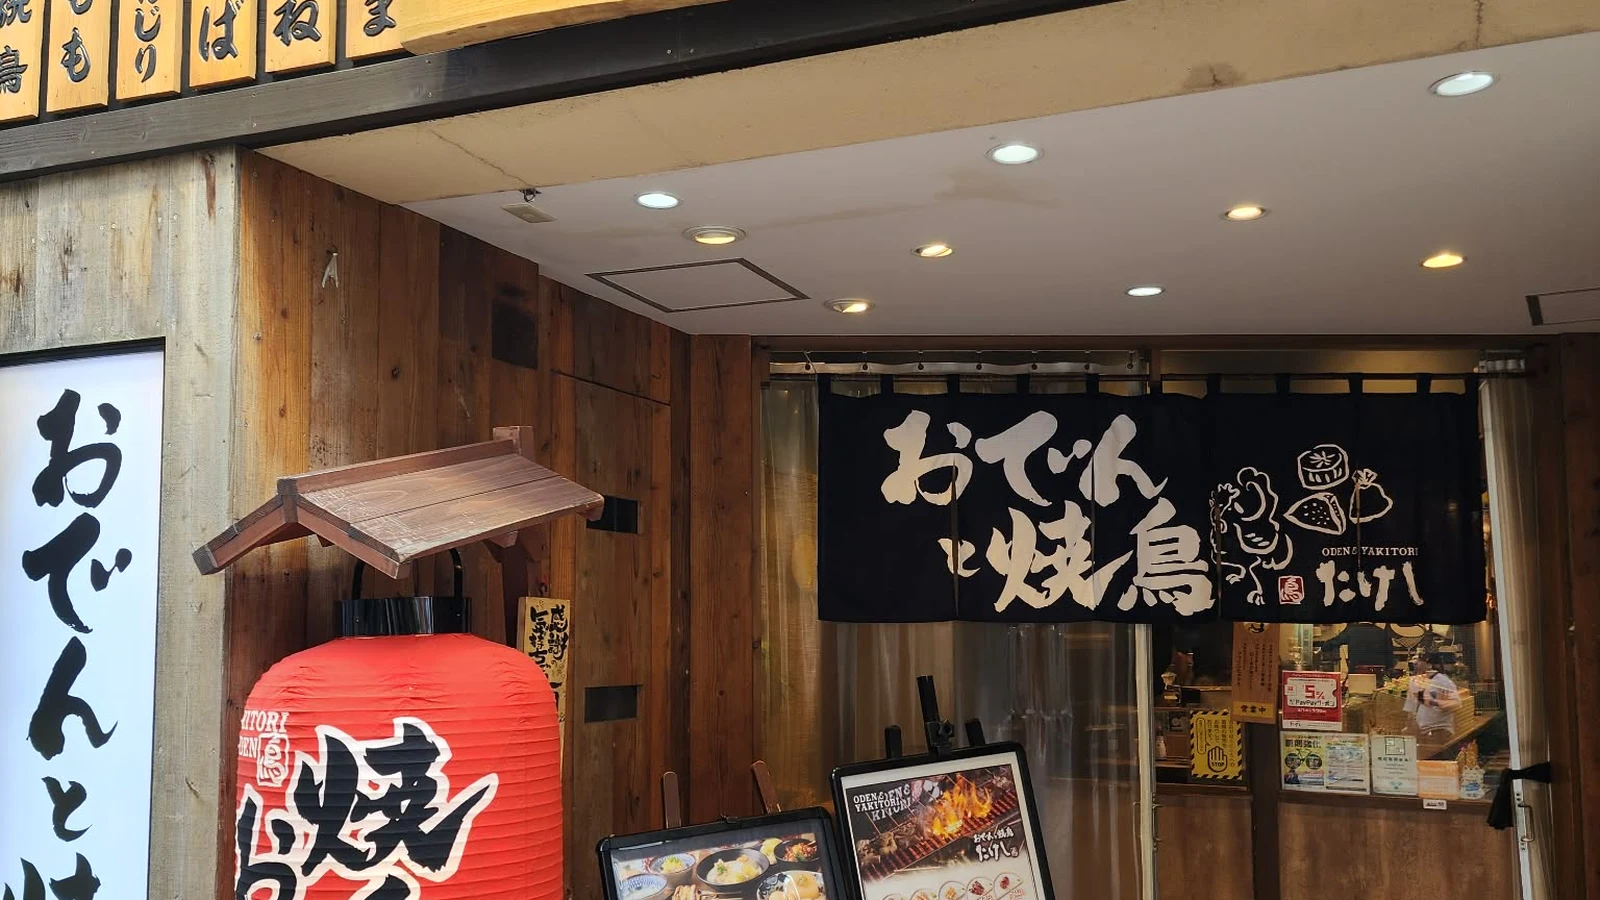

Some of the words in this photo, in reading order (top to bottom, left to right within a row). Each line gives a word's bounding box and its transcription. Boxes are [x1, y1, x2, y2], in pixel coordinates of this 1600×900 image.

[134, 0, 161, 83] じり
[273, 0, 322, 46] ね
[880, 409, 1168, 506] おでん
[938, 496, 1216, 616] と焼鳥
[1321, 546, 1350, 556] ODEN
[1361, 546, 1418, 557] YAKITORI
[1315, 559, 1424, 612] たけし
[853, 792, 877, 804] ODEN
[855, 797, 901, 813] YAKITORI
